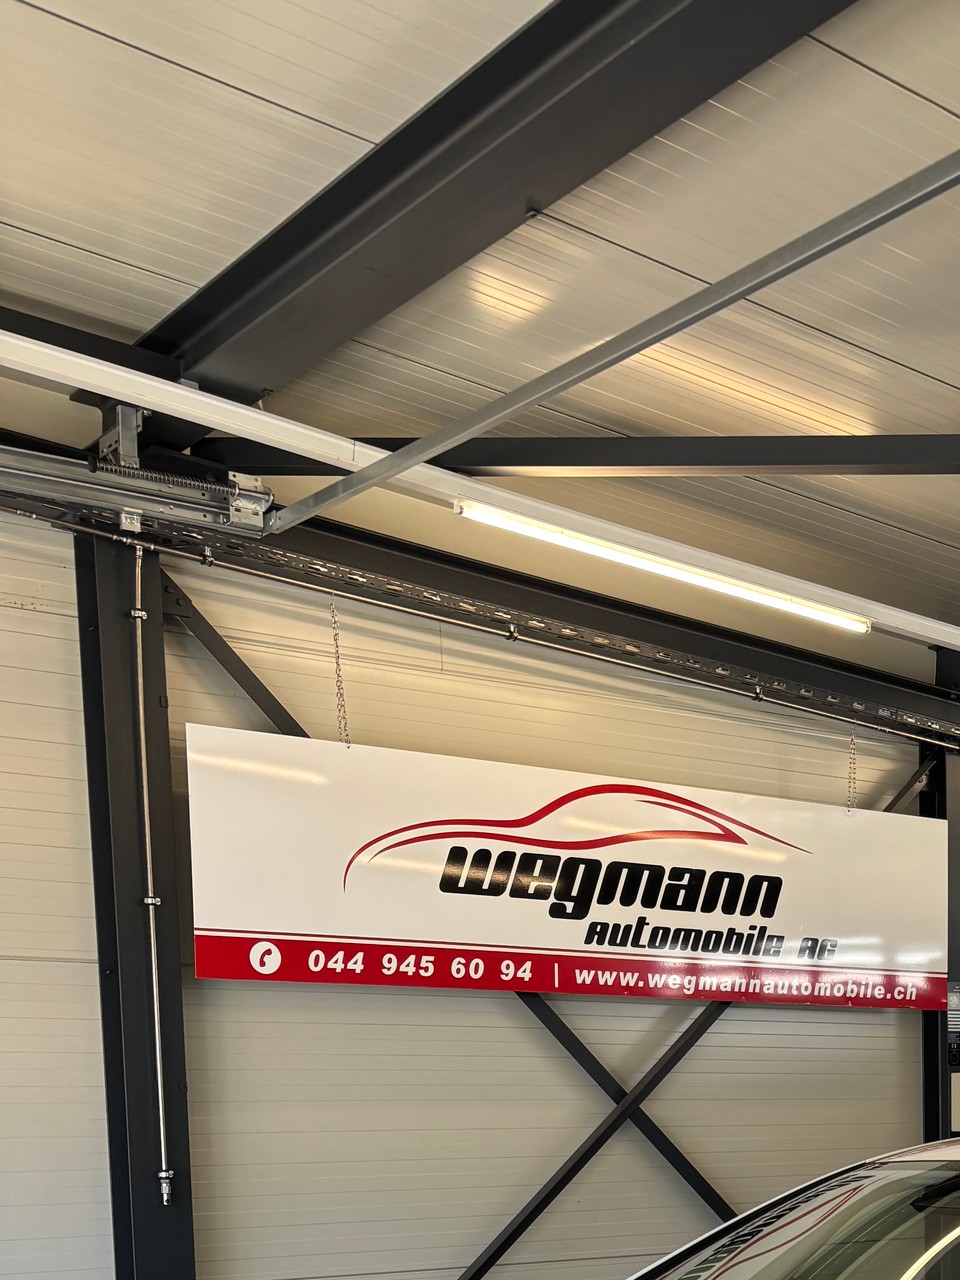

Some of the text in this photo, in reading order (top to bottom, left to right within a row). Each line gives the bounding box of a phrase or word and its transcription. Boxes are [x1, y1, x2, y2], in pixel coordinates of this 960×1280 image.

[438, 845, 783, 920] wegmann
[797, 937, 838, 960] AG
[308, 949, 918, 1002] 044 945 60 94 www.wegmannautomobile.ch
